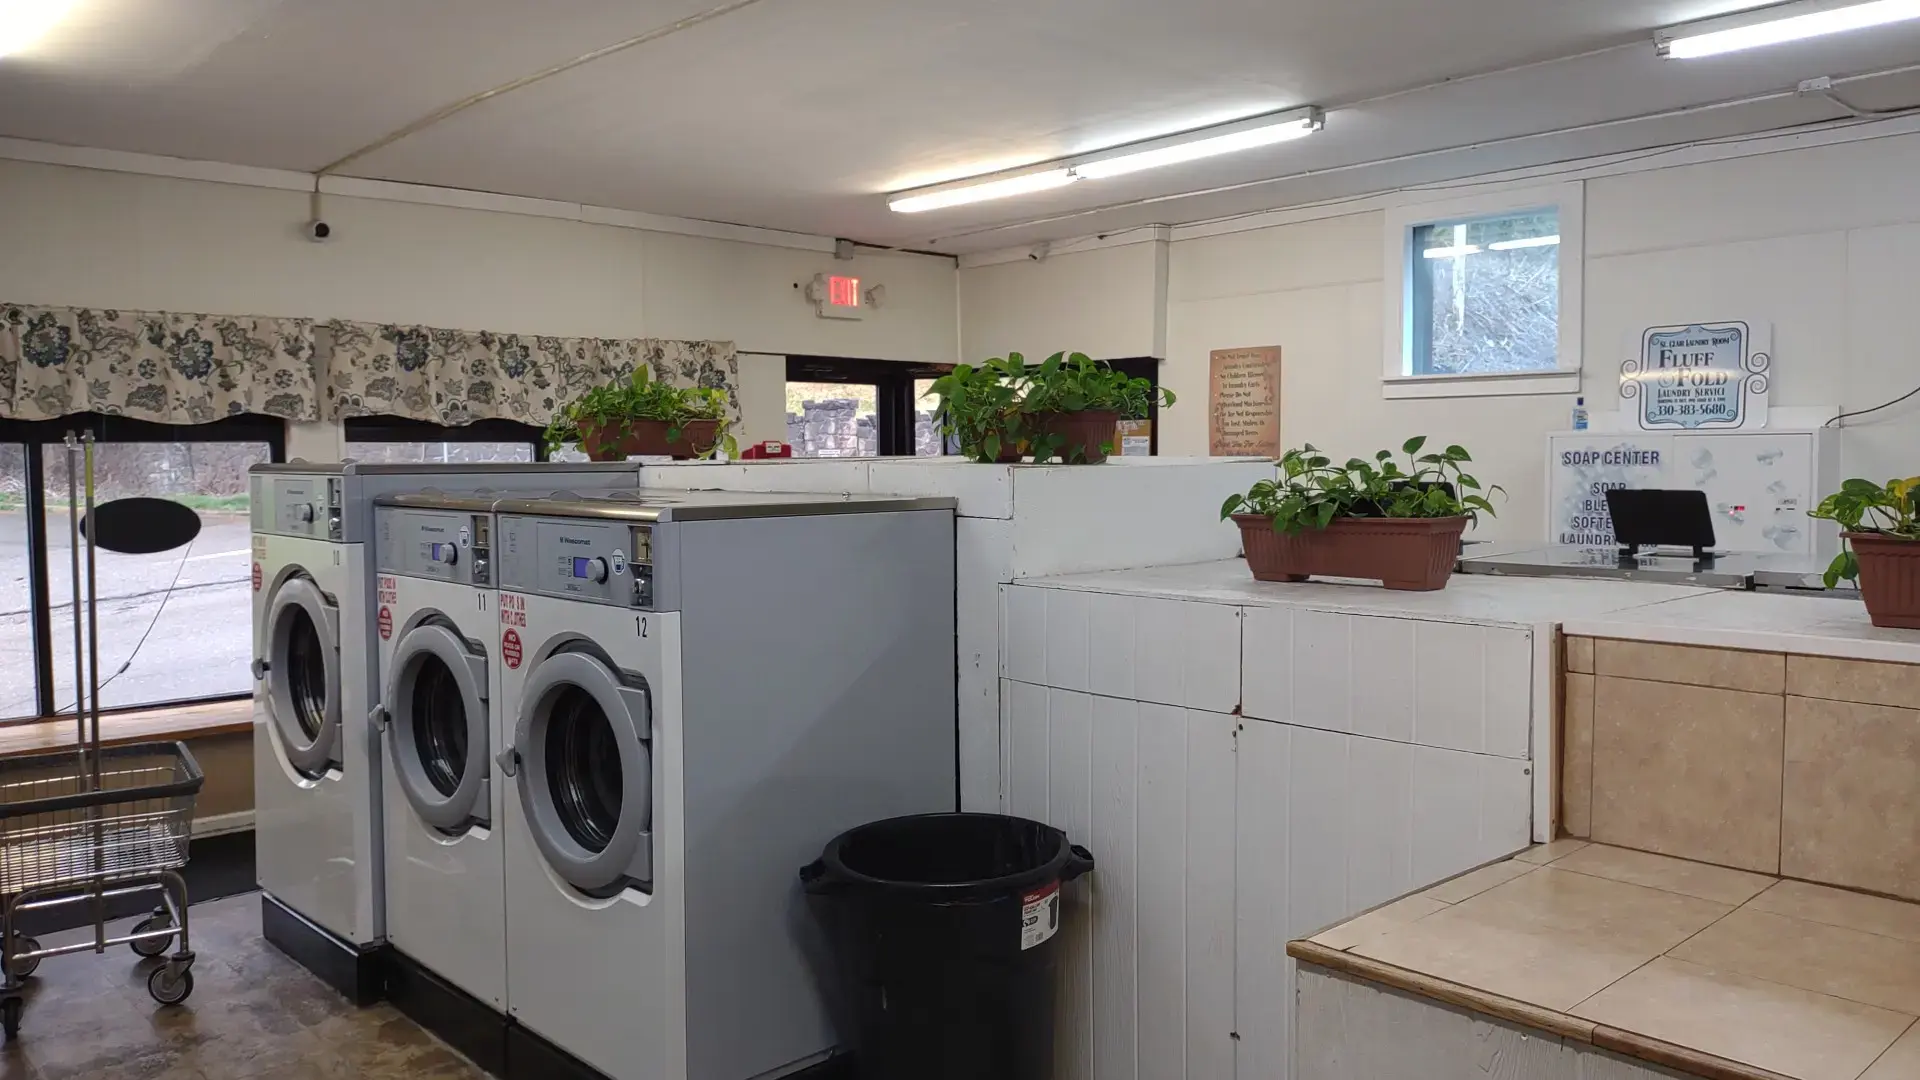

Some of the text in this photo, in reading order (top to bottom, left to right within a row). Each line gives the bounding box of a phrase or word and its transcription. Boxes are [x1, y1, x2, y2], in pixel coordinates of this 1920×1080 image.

[829, 276, 859, 307] EXIT
[1685, 339, 1709, 347] LAUNDRY
[1712, 337, 1730, 347] ROOM
[1659, 349, 1715, 368] FLUFF
[1676, 368, 1728, 387] FOLD
[1657, 388, 1691, 398] LAUNDRY
[1657, 403, 1726, 416] 330-383-5680
[1563, 451, 1660, 465] SOAP CENTER
[1585, 500, 1608, 511] BLE
[1572, 516, 1613, 529] SOFTE
[478, 593, 486, 611] 11
[636, 616, 647, 638] 12
[508, 633, 516, 641] NO
